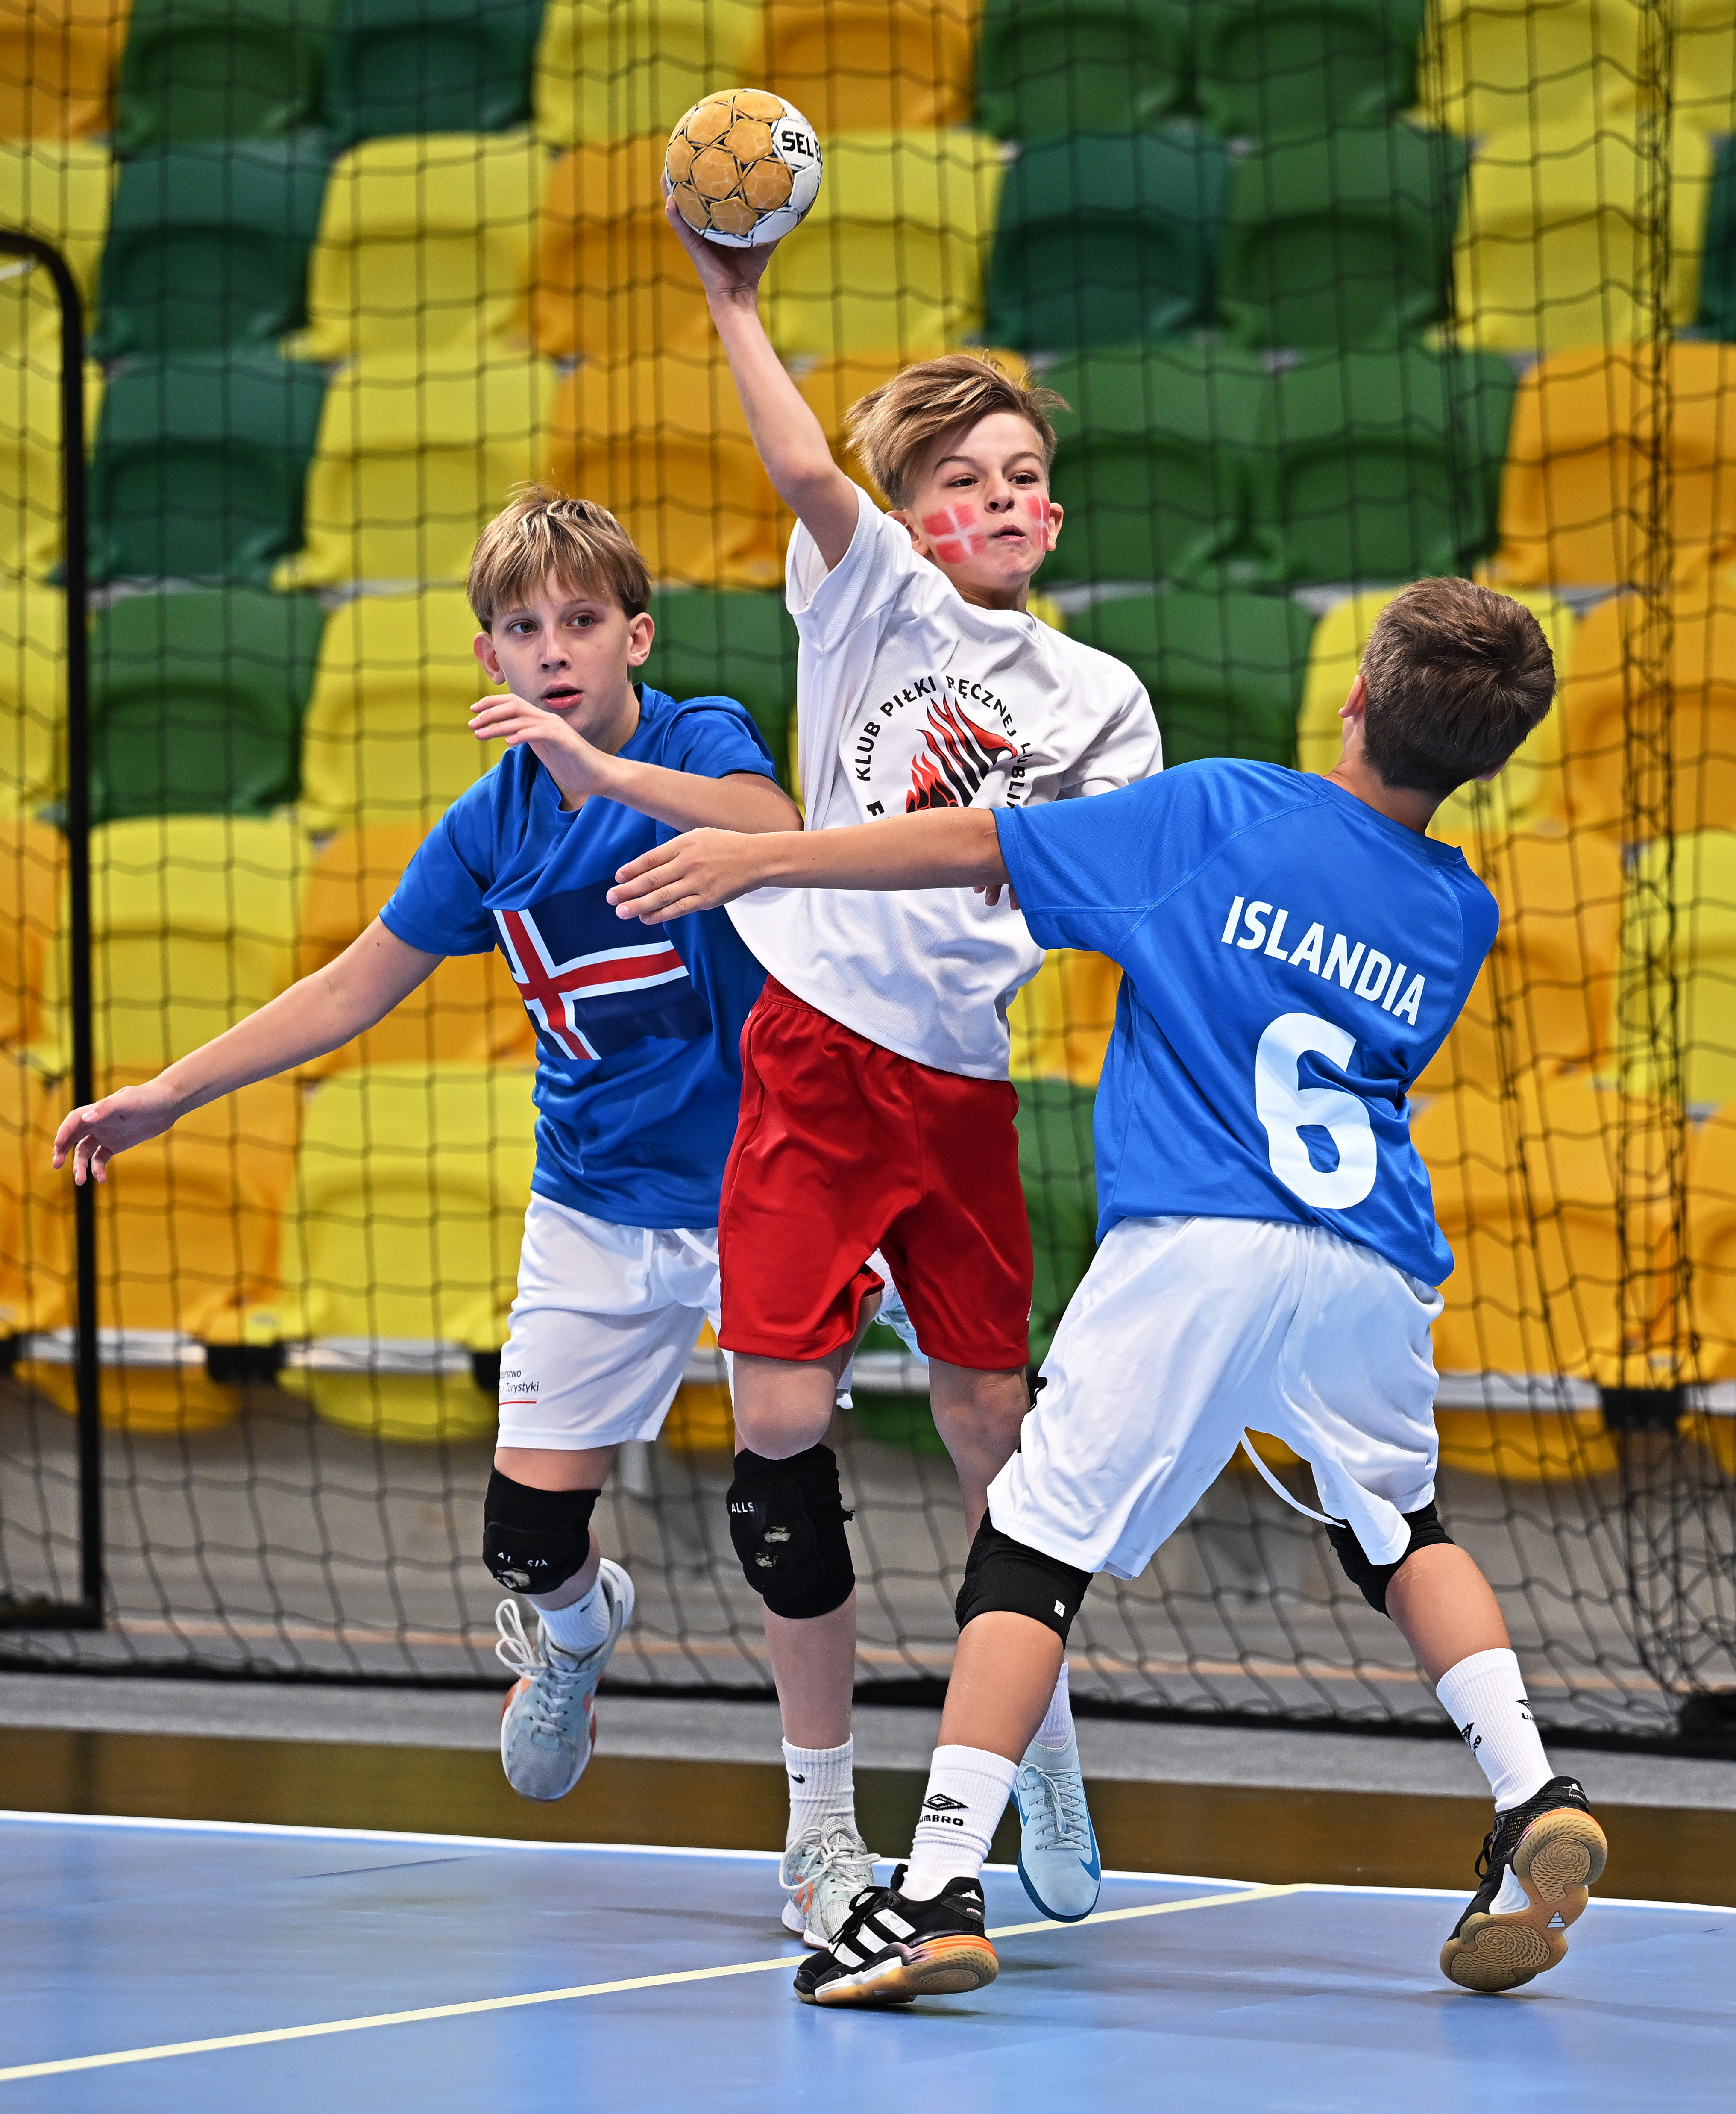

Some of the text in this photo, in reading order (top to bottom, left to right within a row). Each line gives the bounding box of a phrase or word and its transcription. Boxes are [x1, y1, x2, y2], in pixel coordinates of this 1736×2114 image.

[855, 722, 880, 781] KLUB
[880, 676, 936, 717] PIŁKI
[946, 675, 1017, 737] RĘCZNEJ
[1221, 896, 1425, 1026] ISLANDIA
[1255, 1012, 1377, 1210] 6
[506, 1381, 539, 1394] Turystyki
